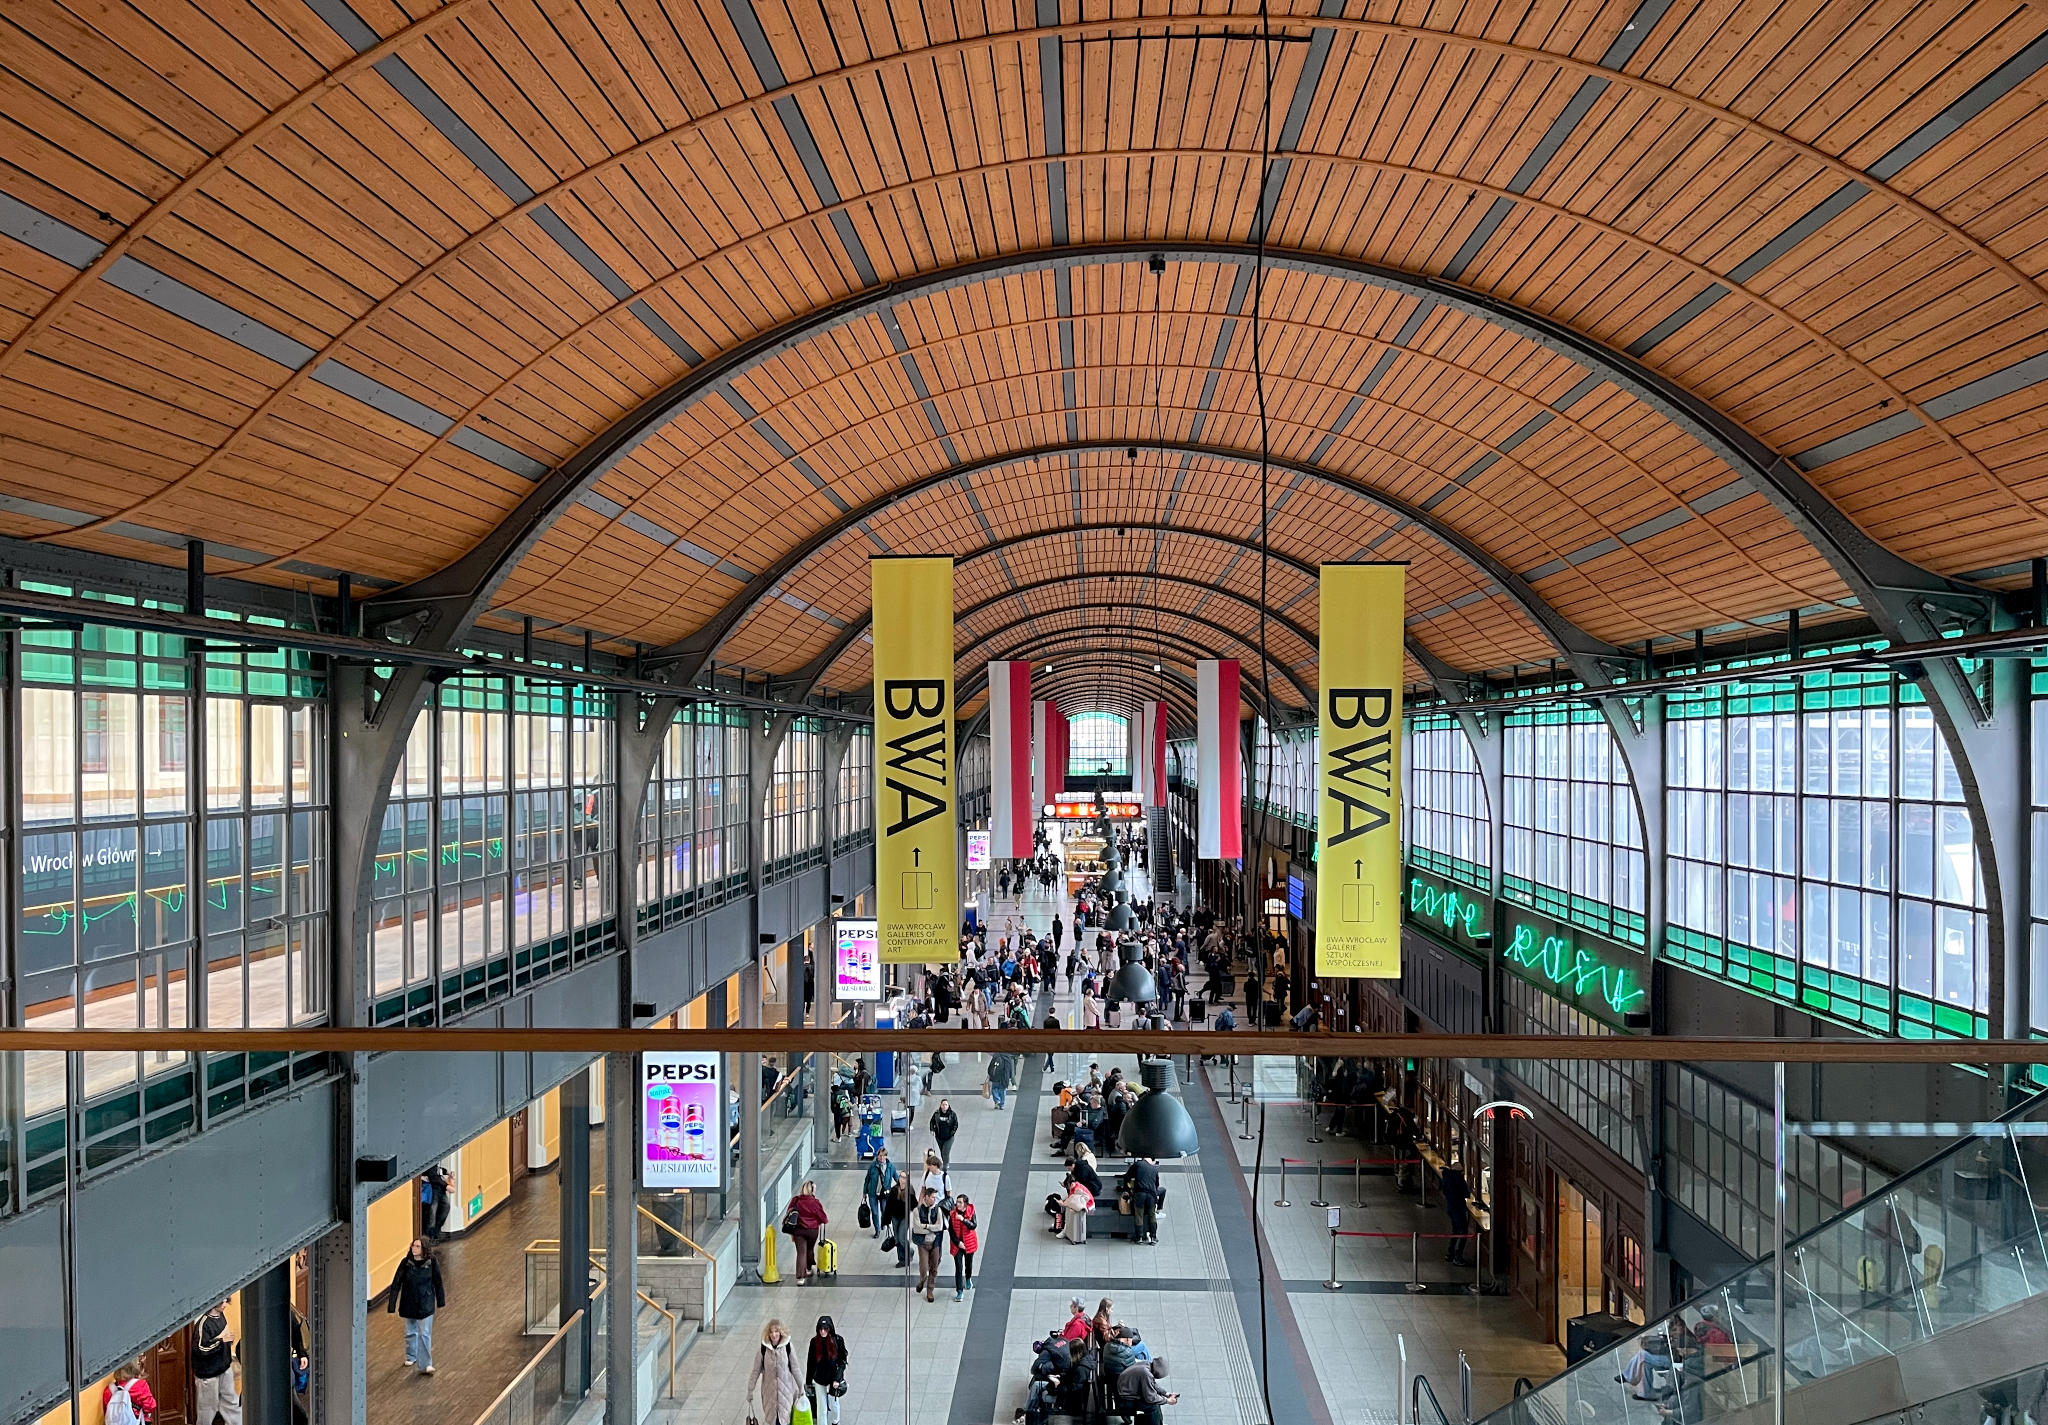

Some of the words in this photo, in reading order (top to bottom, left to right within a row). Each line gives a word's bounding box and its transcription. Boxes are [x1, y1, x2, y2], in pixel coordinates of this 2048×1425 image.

[884, 679, 946, 837] BWA
[1327, 688, 1392, 848] BWA
[30, 850, 94, 874] Wrocłw
[887, 923, 904, 931] BWA
[906, 923, 946, 931] WROCŁAW
[1345, 936, 1388, 944] WROCŁAW
[1326, 959, 1383, 967] WSPÓŁCZESNEJ
[647, 1064, 716, 1080] PEPSI
